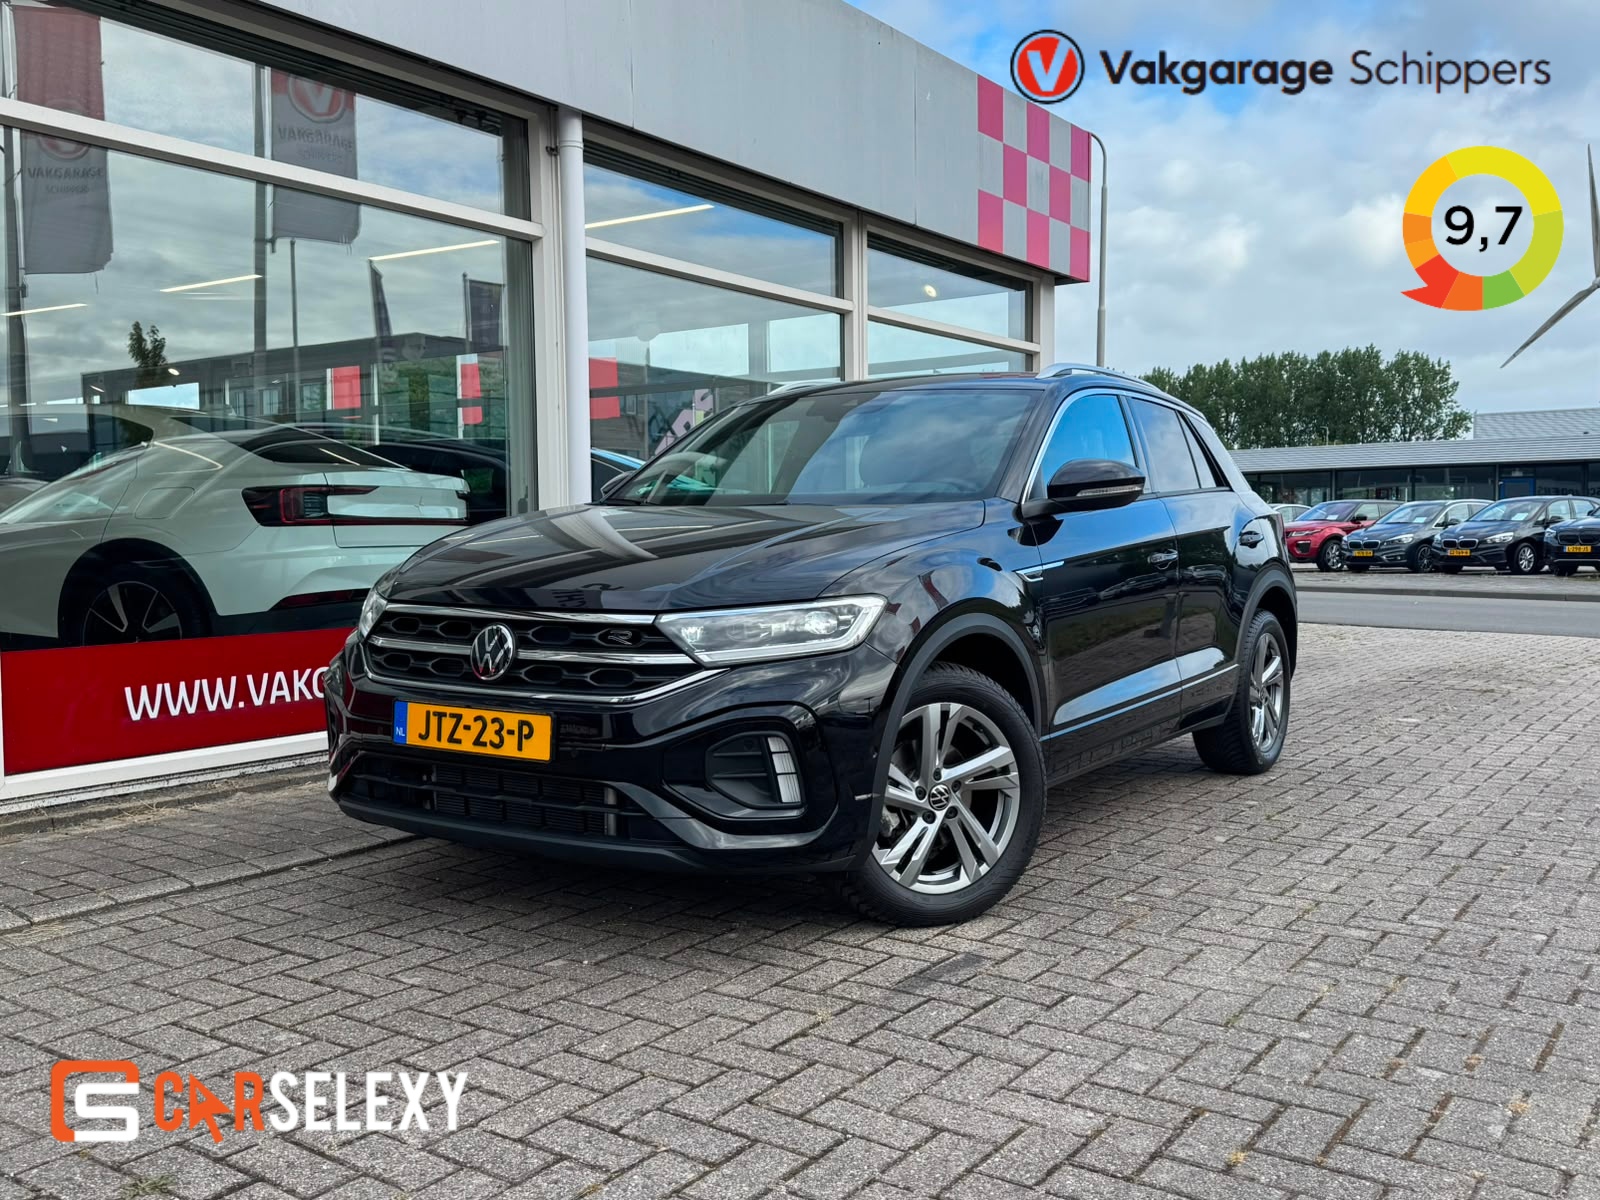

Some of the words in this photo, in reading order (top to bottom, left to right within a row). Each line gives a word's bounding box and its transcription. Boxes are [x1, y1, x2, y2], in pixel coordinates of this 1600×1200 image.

[27, 166, 104, 179] VAKGARAGE
[395, 726, 405, 737] NL
[418, 710, 534, 752] JTZ-23-P
